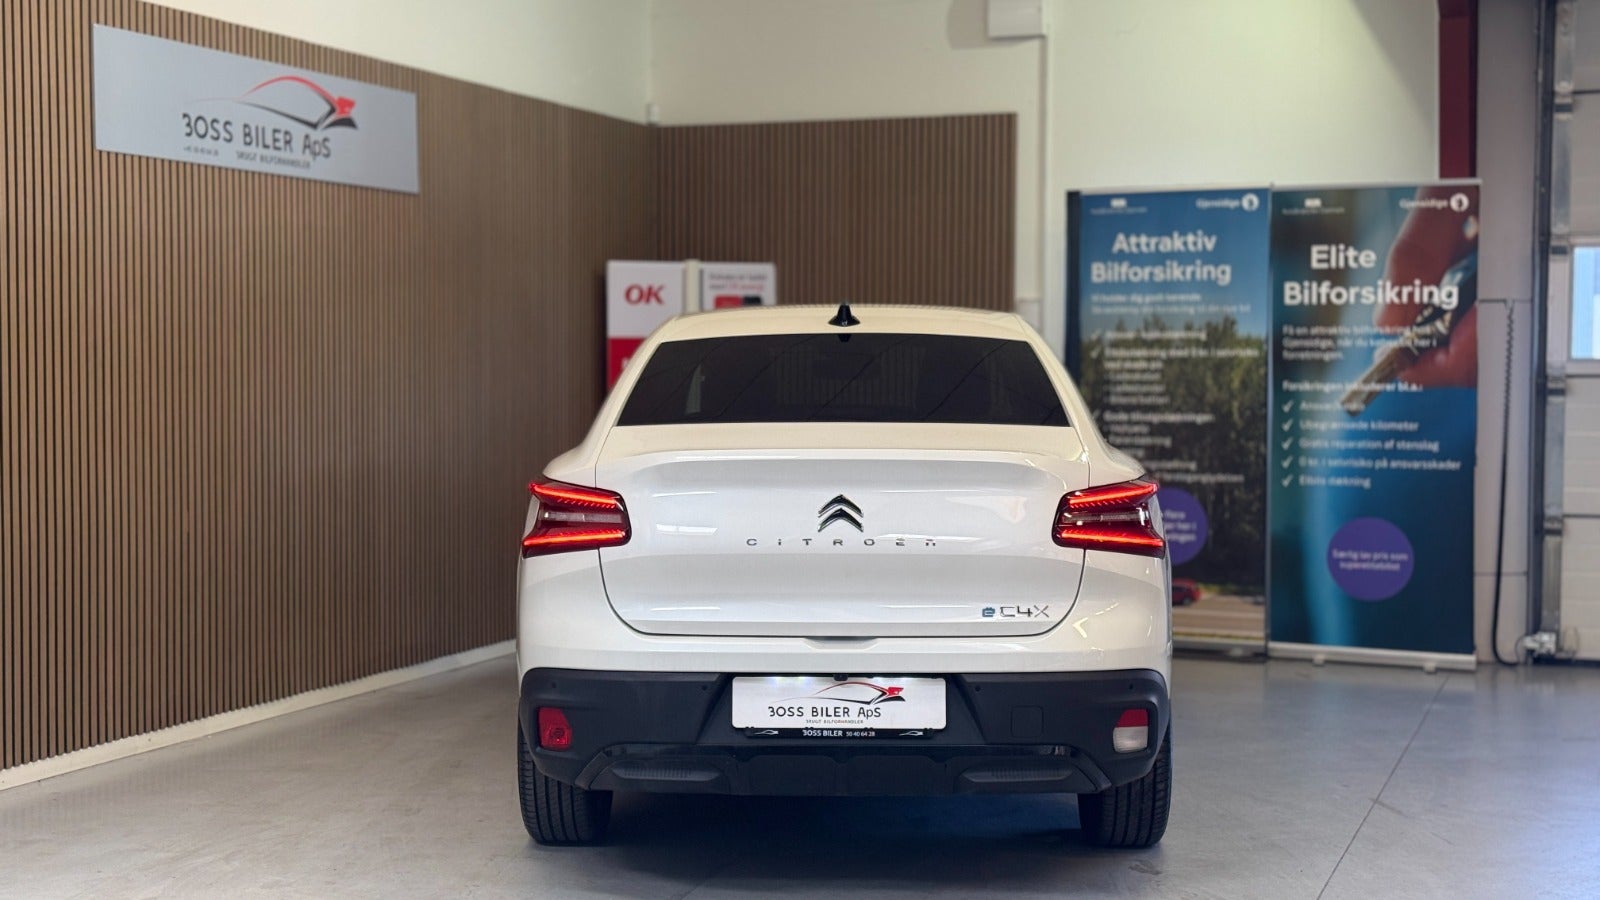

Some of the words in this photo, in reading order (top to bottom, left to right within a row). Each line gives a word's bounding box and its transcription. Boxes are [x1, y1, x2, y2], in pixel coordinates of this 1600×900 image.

[243, 123, 294, 153] BILER
[302, 133, 331, 161] ApS
[1112, 229, 1217, 253] Attraktiv
[1310, 243, 1377, 269] Elite
[1090, 260, 1232, 286] Bilforsikring
[624, 283, 665, 305] OK
[1283, 279, 1459, 310] Bilforsikring
[811, 706, 850, 717] BILER
[857, 707, 881, 719] ApS
[822, 729, 843, 737] BILER
